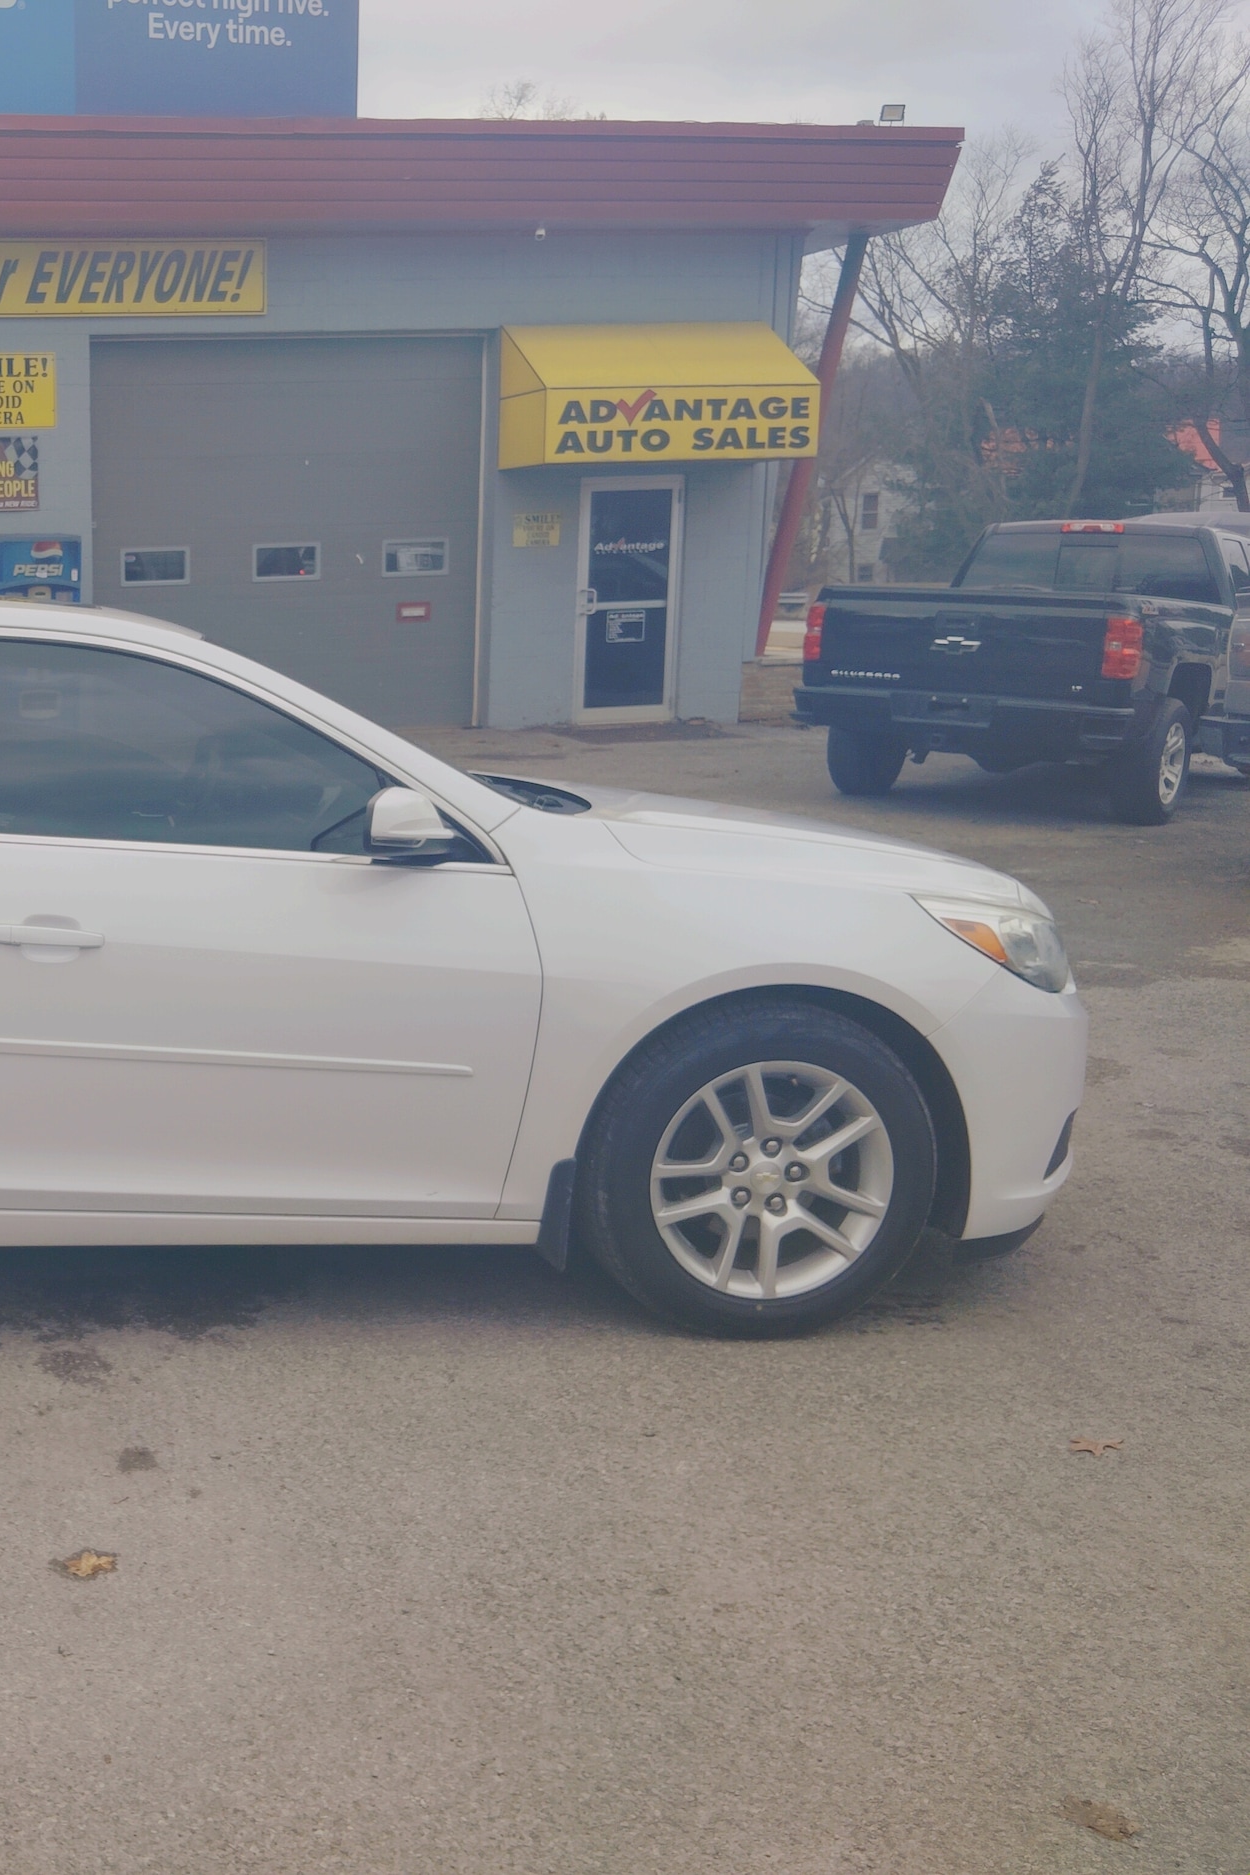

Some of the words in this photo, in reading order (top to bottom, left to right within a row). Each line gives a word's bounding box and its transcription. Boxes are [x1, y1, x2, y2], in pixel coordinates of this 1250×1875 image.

[147, 12, 221, 49] Every
[225, 16, 293, 47] time.
[25, 248, 255, 305] EVERYONE!
[12, 380, 35, 394] ON
[557, 389, 810, 425] ADVANTAGE
[554, 428, 671, 454] AUTO
[690, 425, 811, 451] SALES
[13, 564, 64, 578] PEPSI
